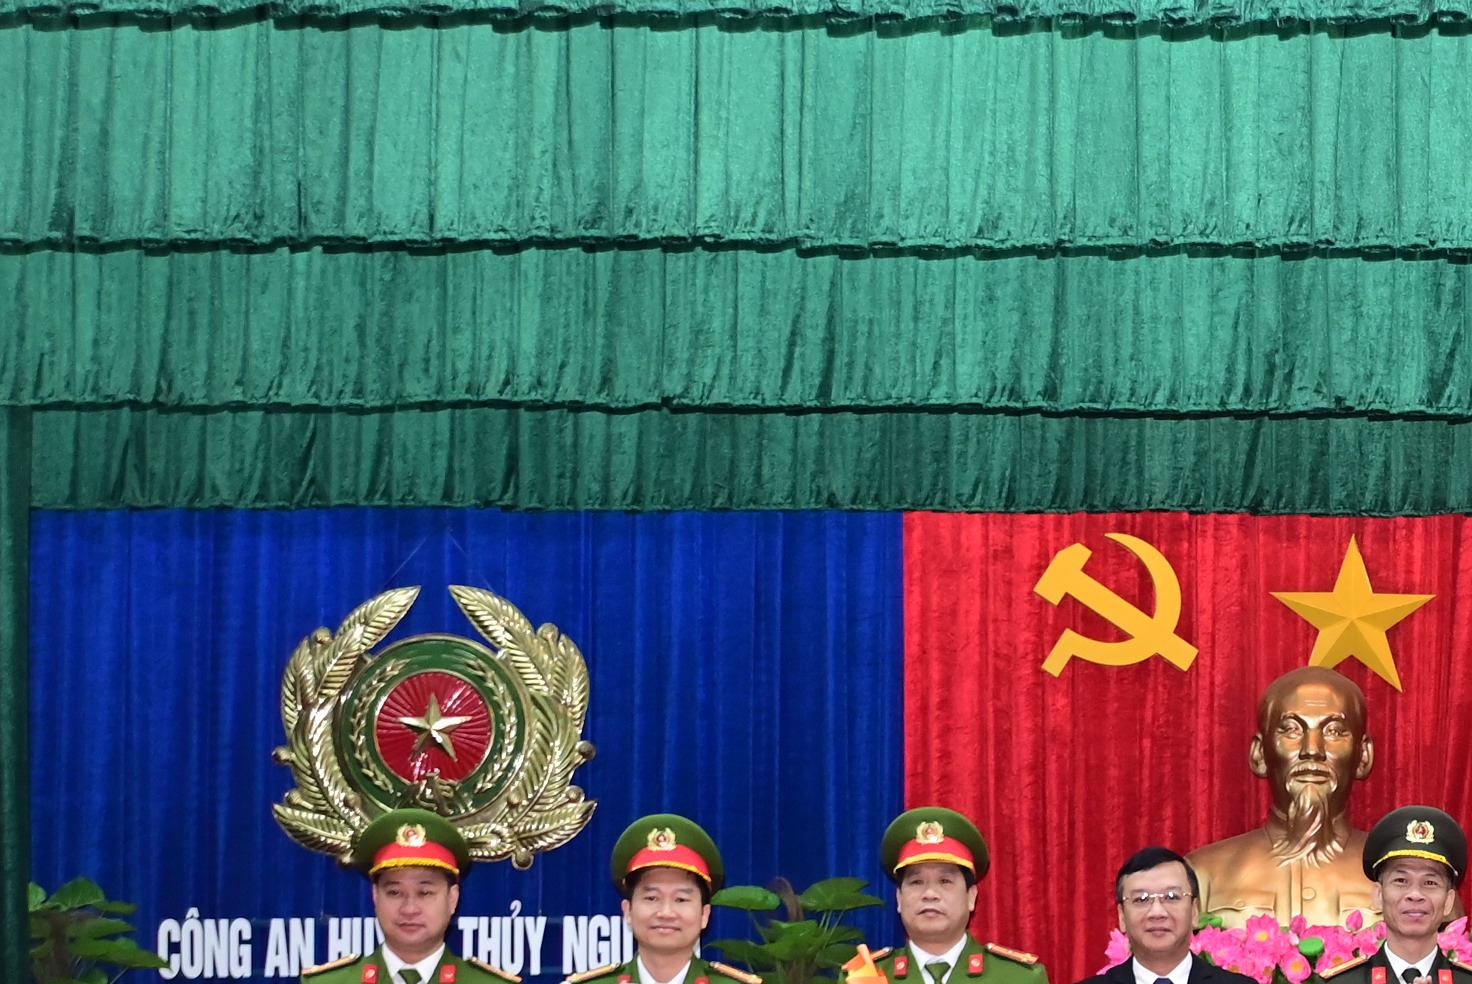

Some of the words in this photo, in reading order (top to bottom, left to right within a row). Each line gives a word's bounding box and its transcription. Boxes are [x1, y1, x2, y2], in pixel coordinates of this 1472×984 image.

[157, 907, 252, 980] CÔNG
[264, 917, 316, 978] AN
[457, 900, 547, 976] THỦY
